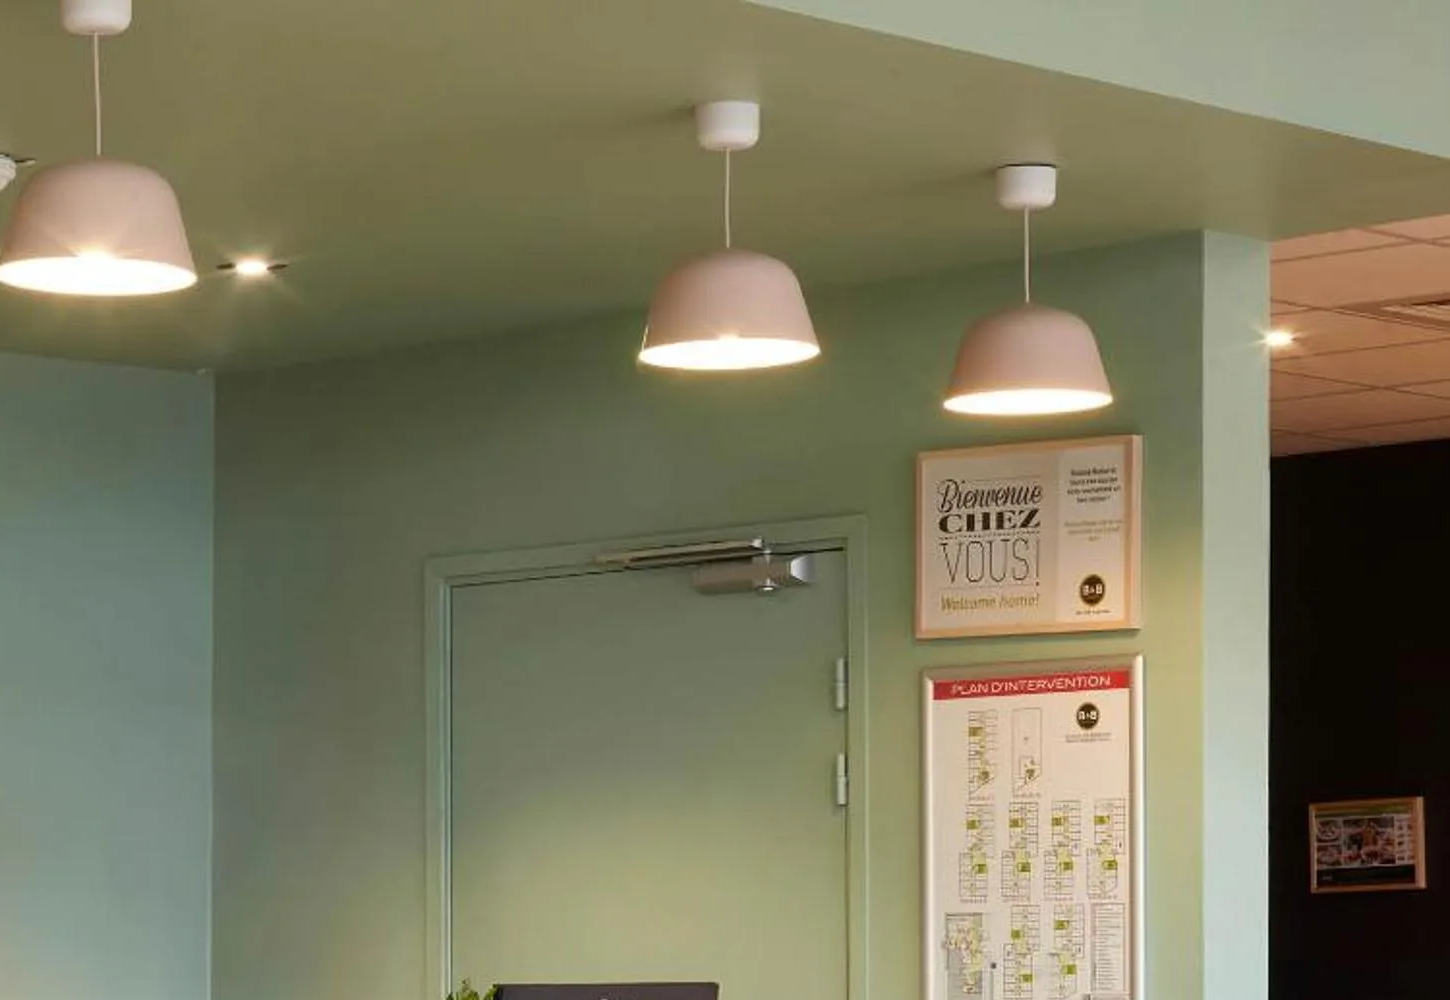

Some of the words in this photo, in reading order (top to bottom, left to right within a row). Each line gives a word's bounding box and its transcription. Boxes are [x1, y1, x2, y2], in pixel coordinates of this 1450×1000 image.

[937, 478, 1043, 514] Bienvenue
[938, 508, 1042, 534] CHEZ
[941, 595, 997, 612] Welcome
[951, 683, 989, 696] PLAN
[990, 675, 1112, 693] D'INTERVENTION
